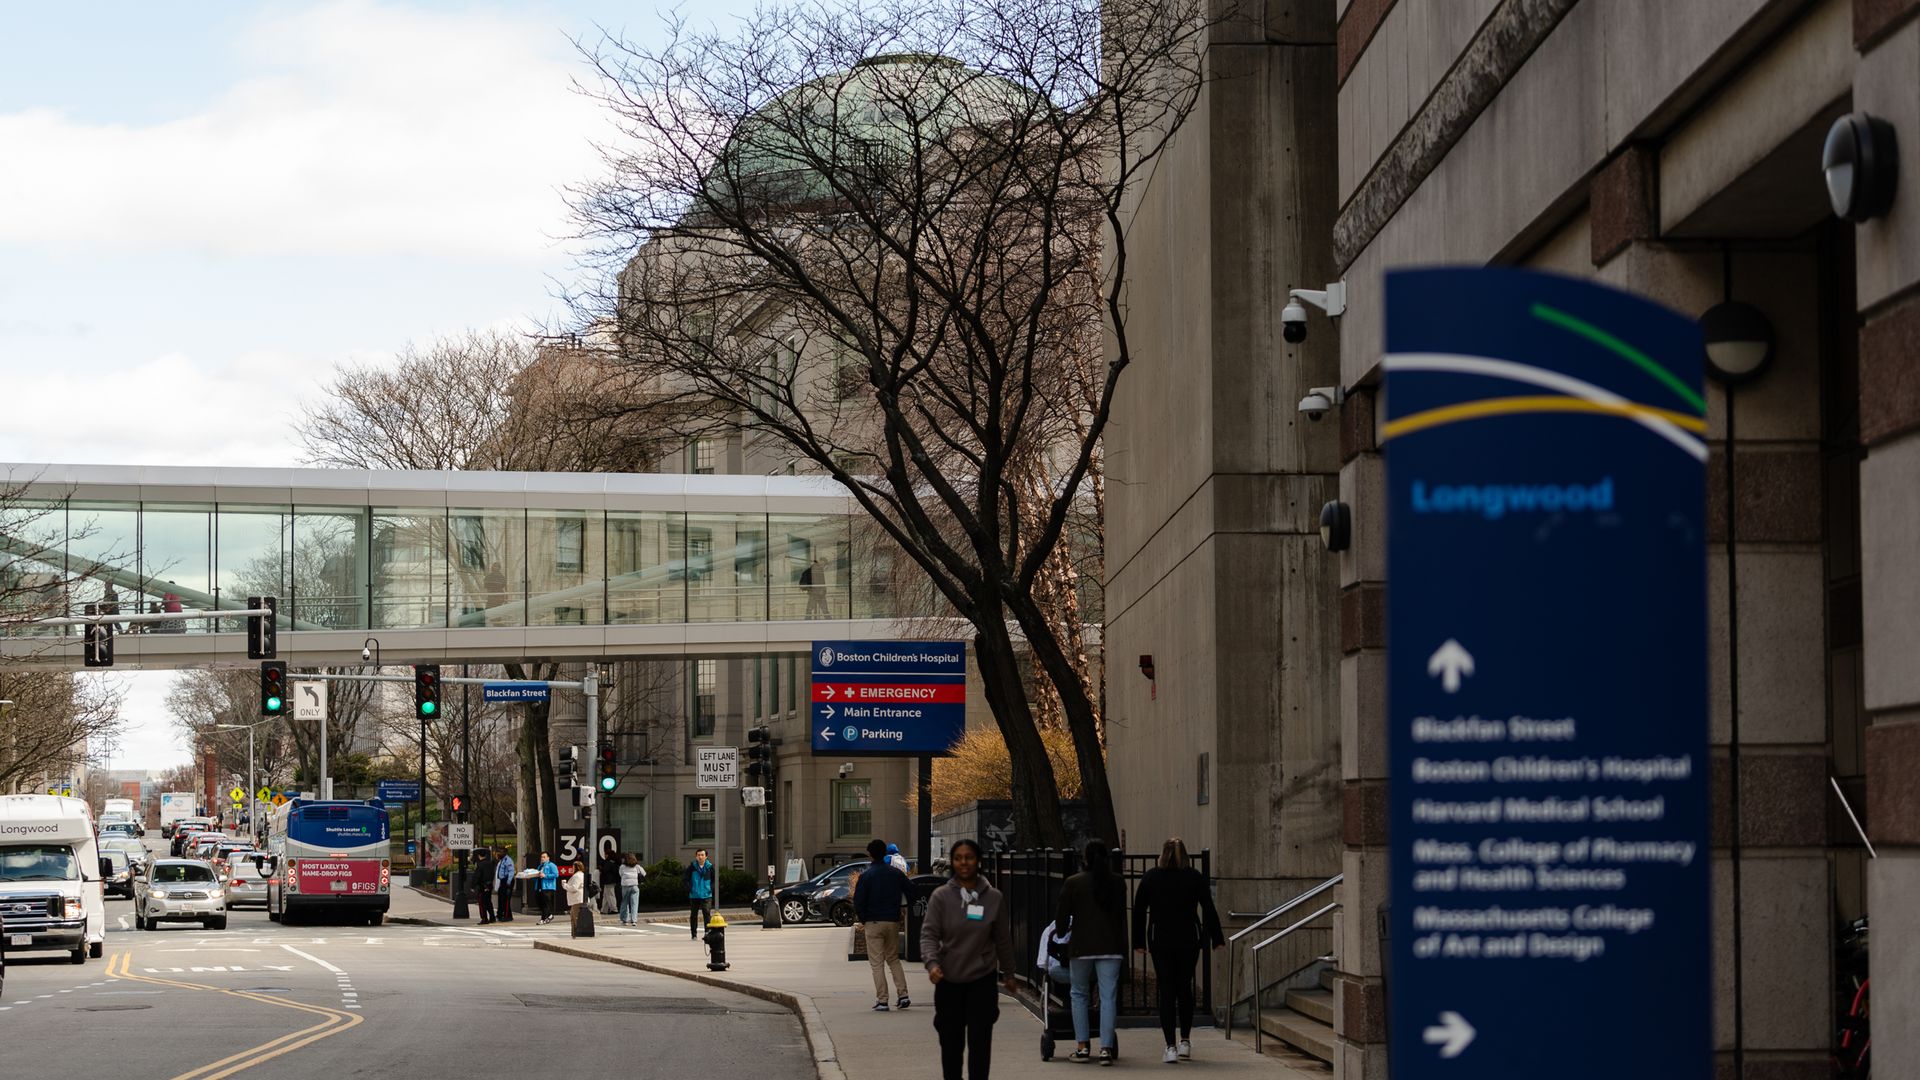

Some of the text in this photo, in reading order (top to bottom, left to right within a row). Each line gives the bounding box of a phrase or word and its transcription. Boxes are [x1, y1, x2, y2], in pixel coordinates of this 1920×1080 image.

[1412, 480, 1612, 518] Longwood
[837, 653, 958, 664] Boston Children's Hospital
[486, 689, 547, 698] Blackfan Street
[861, 688, 936, 698] EMERGENCY
[300, 708, 320, 716] ONLY
[844, 708, 921, 717] Main Entrance
[1412, 717, 1574, 740] Blackfan Street
[862, 729, 902, 740] Parking
[700, 753, 717, 761] LEFT
[704, 763, 730, 771] MUST
[1413, 757, 1691, 785] Boston Children's Hospital
[720, 774, 735, 782] LEFT
[1413, 797, 1664, 821] Harvard Medical School
[1, 824, 58, 835] Longwood
[560, 835, 617, 861] 30
[1414, 838, 1696, 866] Mass. College of Pharmacy
[1415, 865, 1626, 889] and Health Sciences
[1414, 906, 1654, 933] Massachusetts College
[1414, 933, 1604, 961] of Art and Design
